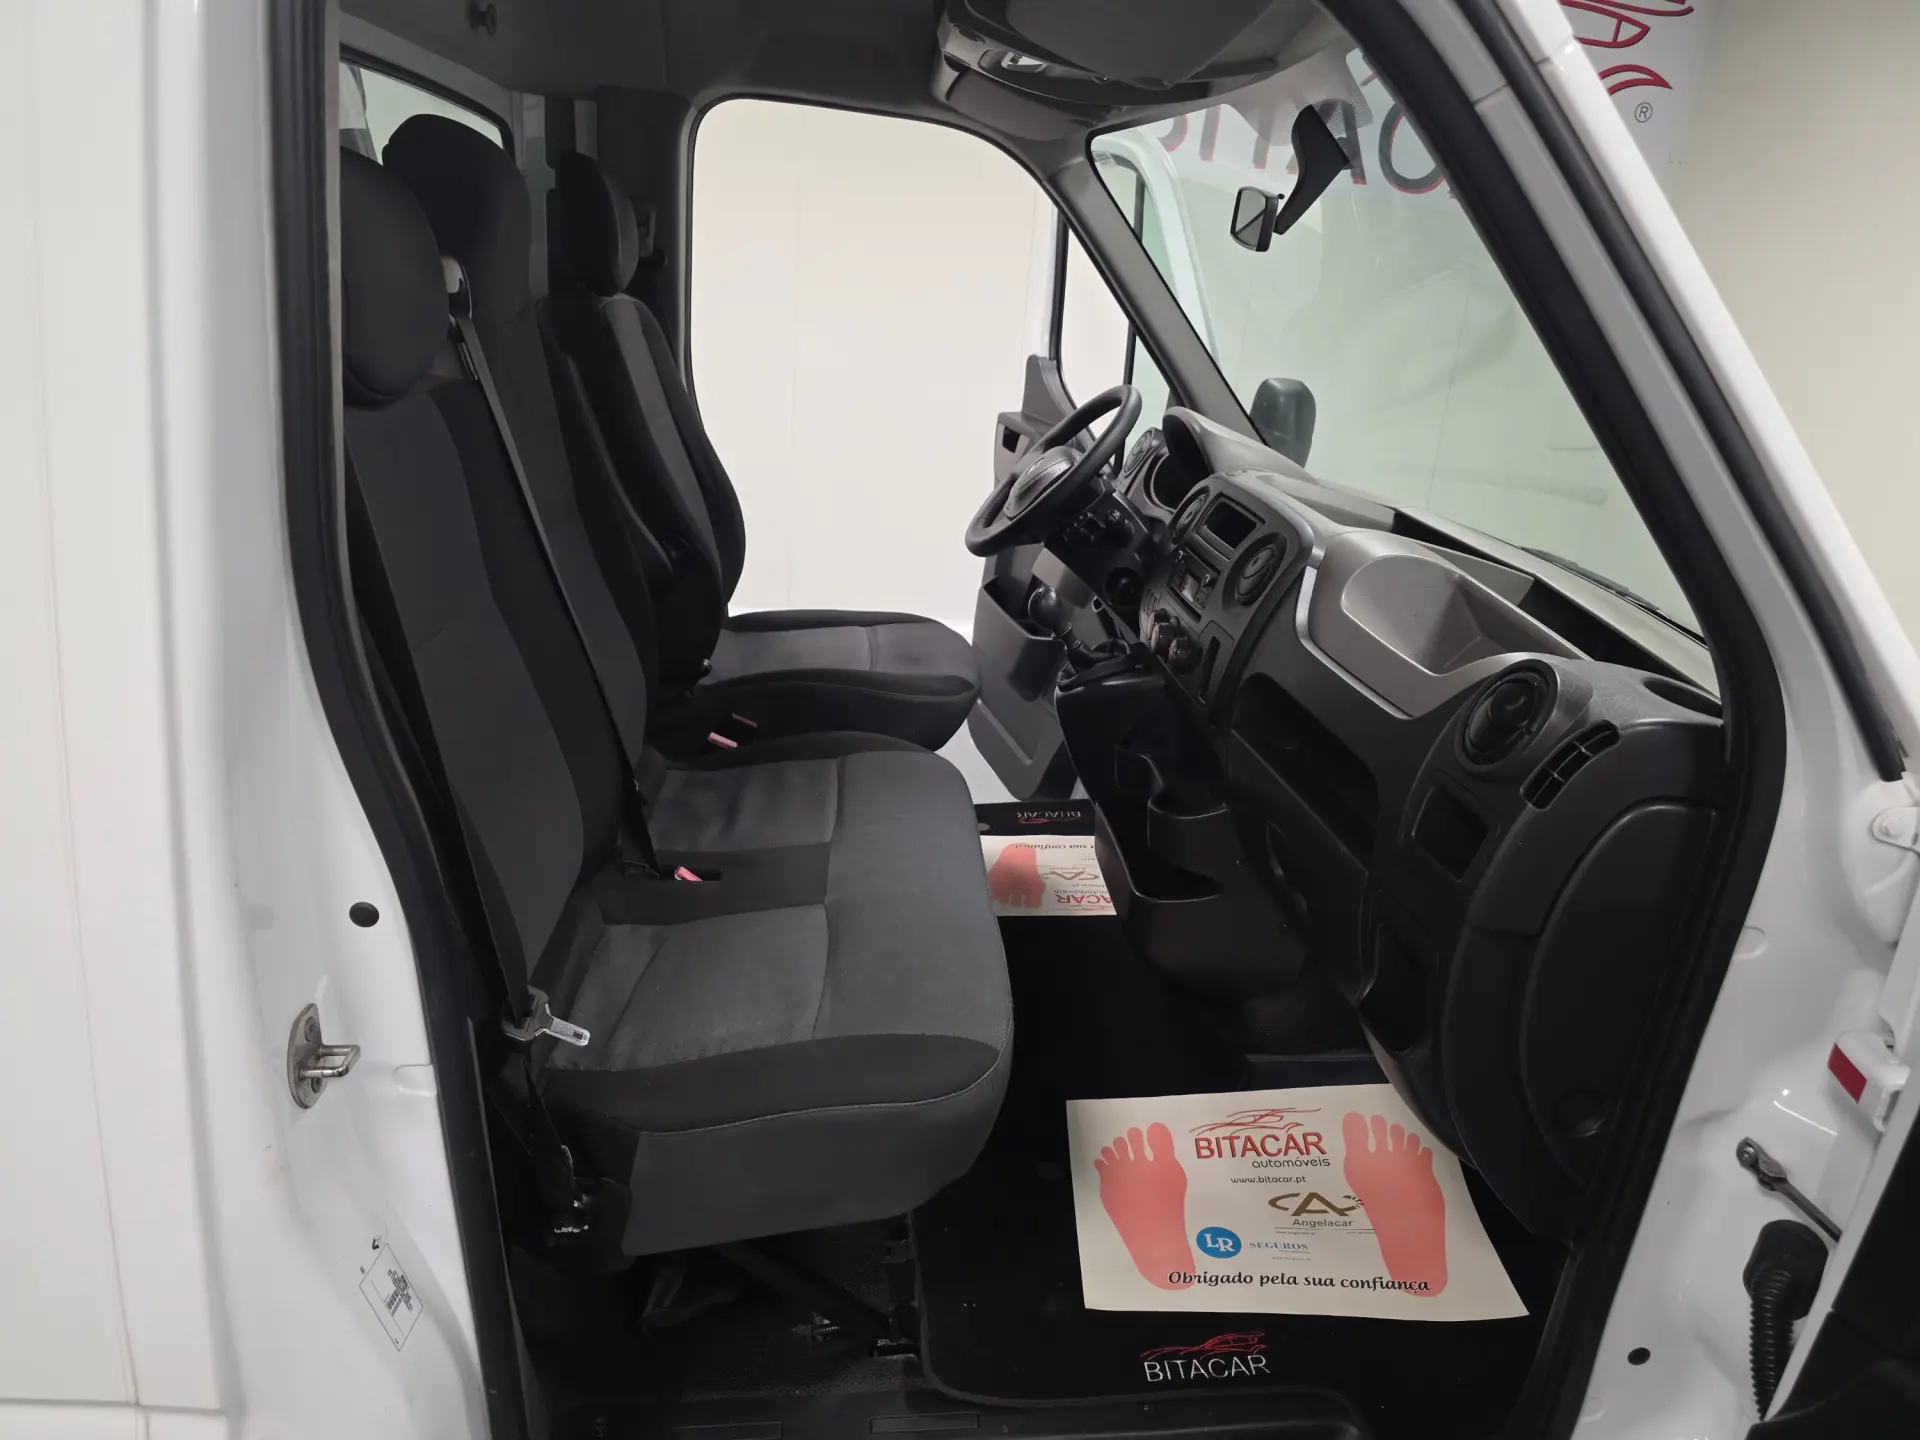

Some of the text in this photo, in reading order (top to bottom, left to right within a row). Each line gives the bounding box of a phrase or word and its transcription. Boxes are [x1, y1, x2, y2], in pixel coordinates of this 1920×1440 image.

[1194, 1131, 1328, 1160] BITACAR
[1251, 1156, 1331, 1169] automóveis
[1230, 1175, 1307, 1184] www.bitacar.pt
[1292, 1218, 1354, 1229] Angelacar
[1203, 1233, 1236, 1252] LR
[1249, 1240, 1309, 1250] SEGUROS
[1168, 1271, 1431, 1294] Obrigado pela sua confiança
[1143, 1354, 1271, 1382] BITACAR
